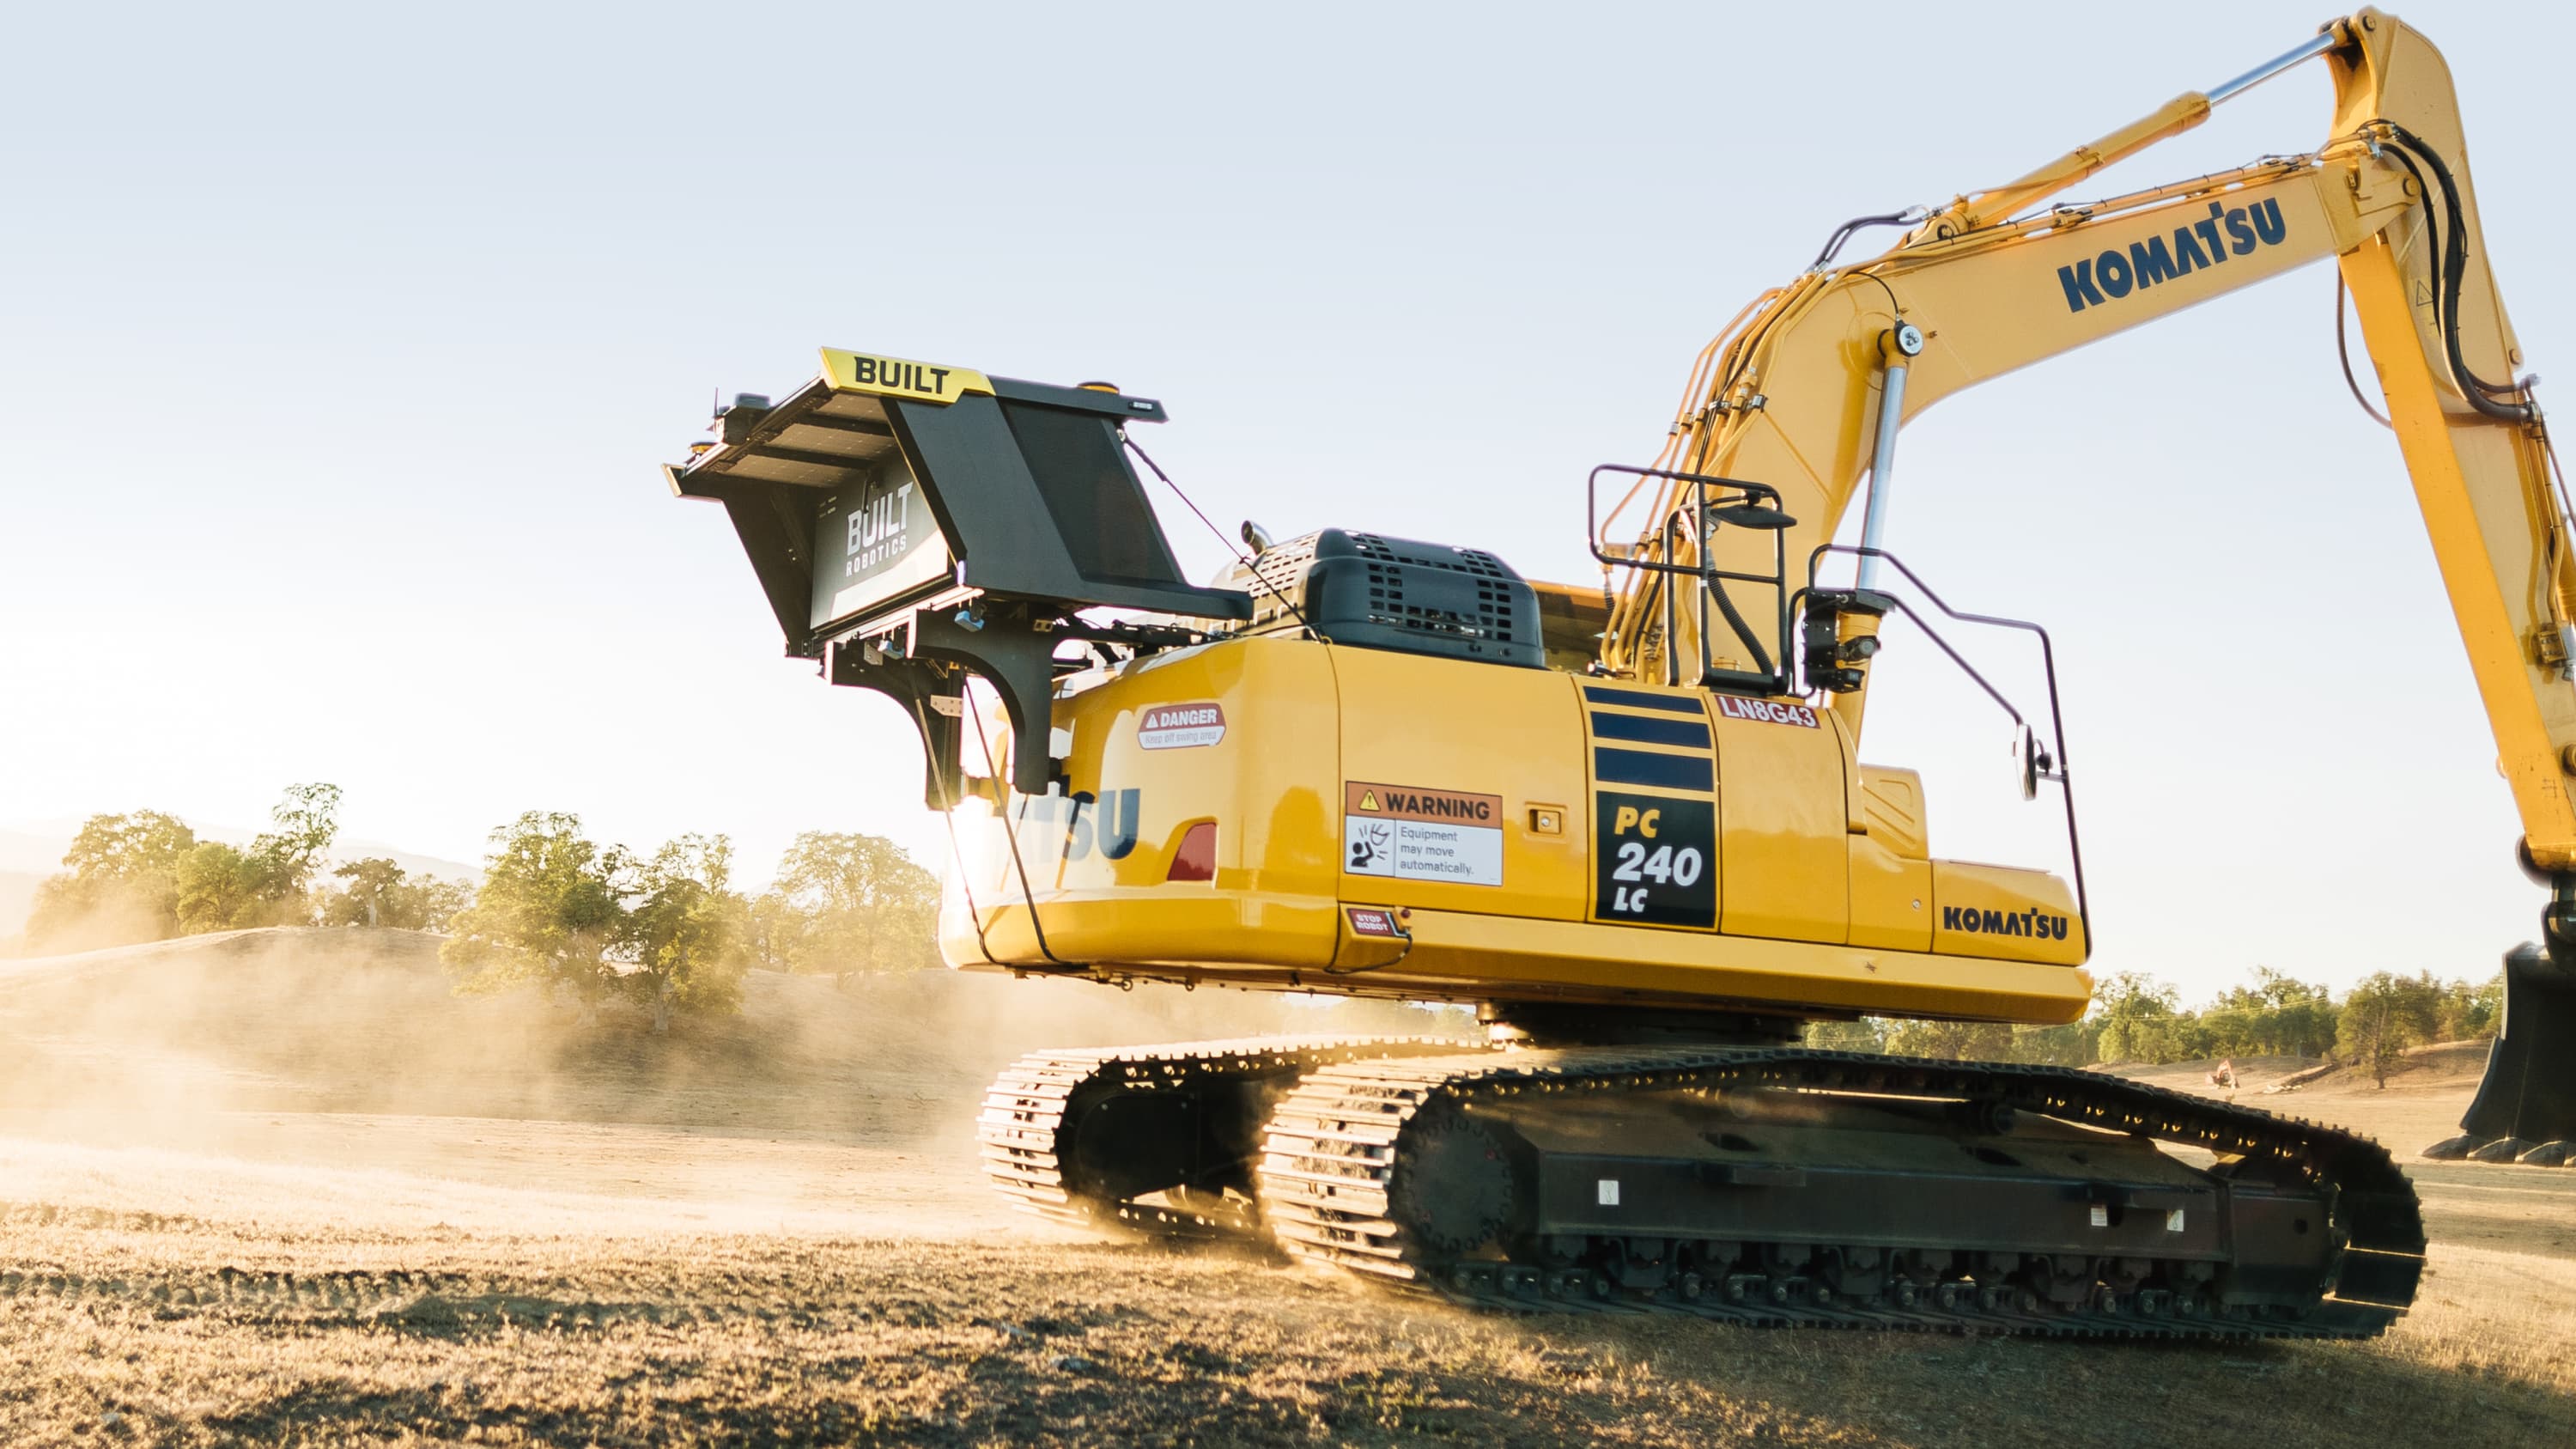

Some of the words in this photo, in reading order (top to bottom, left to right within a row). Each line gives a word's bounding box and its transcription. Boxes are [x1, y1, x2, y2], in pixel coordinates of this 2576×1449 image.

[2057, 197, 2286, 314] KOMATSU
[854, 356, 951, 394] BUILT
[847, 481, 914, 557] BUILT
[845, 534, 907, 577] ROBOTICS
[1160, 709, 1217, 728] DANGER
[1719, 696, 1816, 728] LN8G43
[1145, 734, 1162, 744] Keep
[1164, 733, 1175, 743] off
[1176, 732, 1199, 743] swing
[1385, 792, 1490, 820] WARNING
[1400, 826, 1458, 842] Equipment
[1614, 806, 1661, 838] PC
[1400, 844, 1422, 855] may
[1425, 847, 1455, 857] move
[1613, 842, 1702, 886] 240
[1400, 860, 1474, 877] automatically.
[1613, 886, 1649, 912] LC
[1356, 914, 1382, 923] STOP
[1356, 921, 1388, 931] ROBOT
[1943, 906, 2068, 941] KOMATSU
